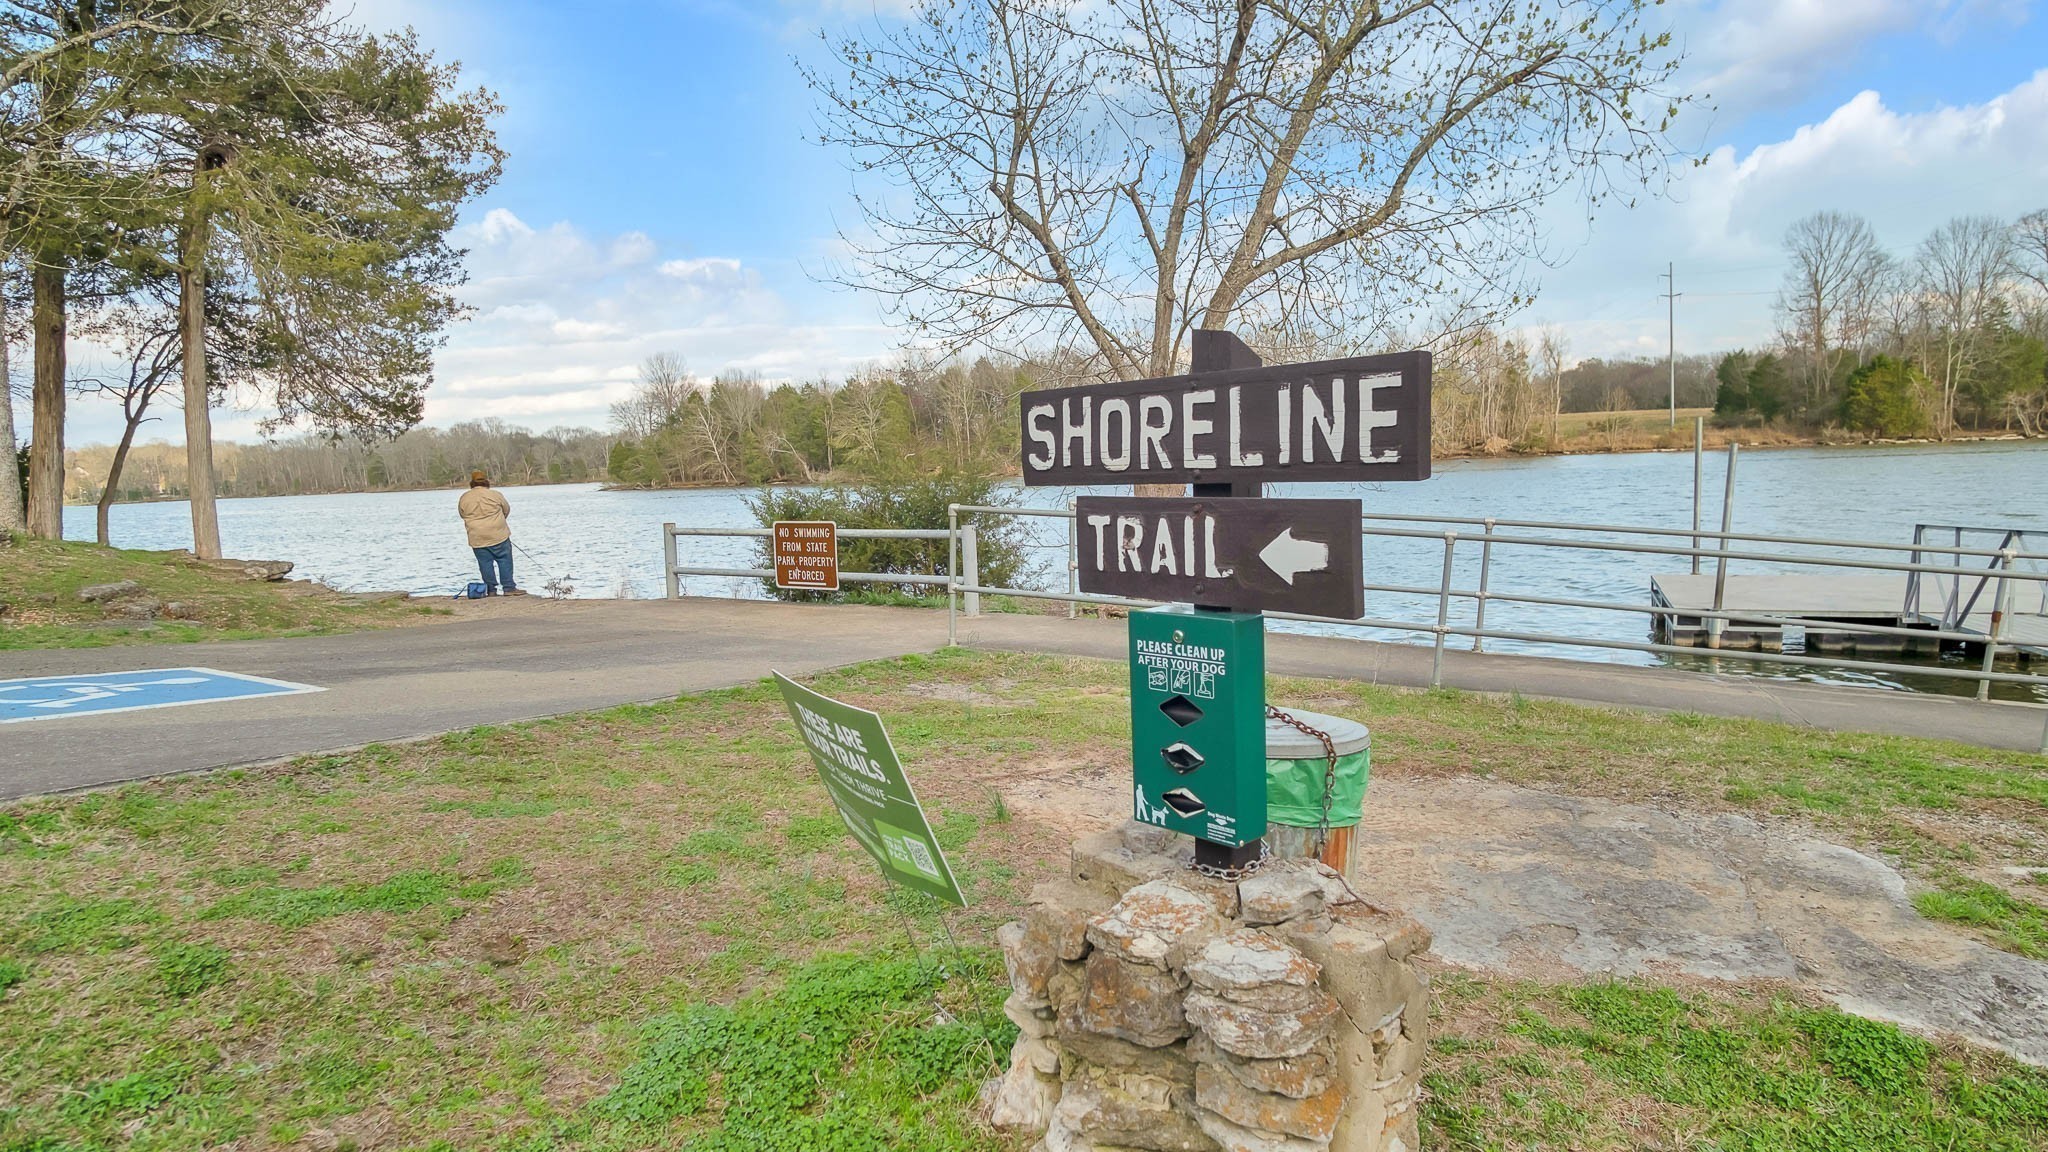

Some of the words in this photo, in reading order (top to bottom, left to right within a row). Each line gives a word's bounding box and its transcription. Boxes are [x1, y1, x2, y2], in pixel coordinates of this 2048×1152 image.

[1027, 371, 1403, 472] SHORELINE
[779, 527, 789, 538] NO
[794, 527, 831, 538] SWIMMING
[782, 541, 802, 552] FROM
[806, 542, 828, 553] STATE
[1088, 515, 1234, 579] TRAIL
[777, 555, 795, 566] PARK
[799, 556, 834, 567] PROPERTY
[788, 570, 825, 581] ENFORCED
[1137, 639, 1173, 656] PLEASE
[1174, 643, 1207, 660] CLEAN
[1210, 648, 1225, 661] UP
[1137, 654, 1168, 669] AFTER
[1170, 657, 1199, 673] YOUR
[1201, 662, 1226, 676] DOG
[794, 701, 836, 740] THESE
[834, 722, 868, 753] ARE
[800, 721, 835, 760] YOUR
[829, 741, 891, 785] TRAILS.
